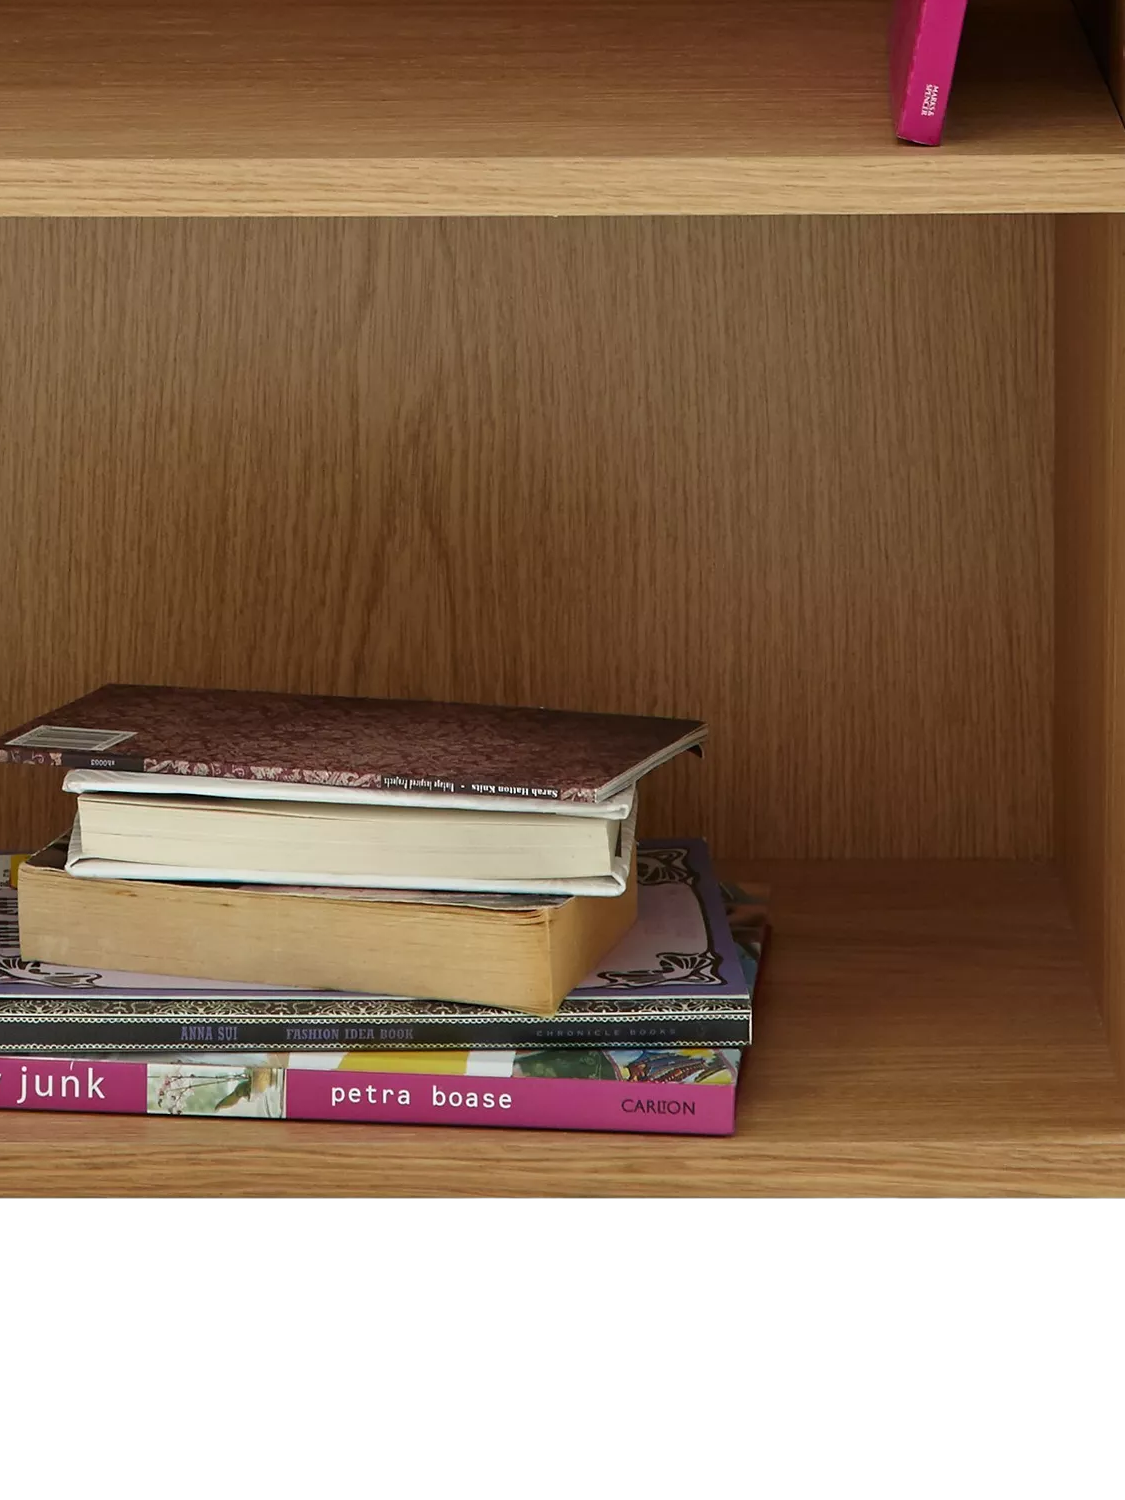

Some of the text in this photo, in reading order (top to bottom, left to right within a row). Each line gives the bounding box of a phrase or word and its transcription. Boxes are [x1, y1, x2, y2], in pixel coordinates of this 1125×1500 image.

[384, 777, 408, 790] Projects
[409, 779, 432, 791] Inspired
[471, 784, 496, 794] Knits
[498, 785, 529, 796] Hatton
[531, 788, 559, 798] Sarah
[180, 1025, 677, 1041] ANNA SUI FASHION IDEA BOOK CHRONICLE BOOKS
[16, 1065, 106, 1104] junk
[331, 1083, 411, 1107] petra
[431, 1084, 513, 1110] boase
[621, 1098, 697, 1116] CARLTON
